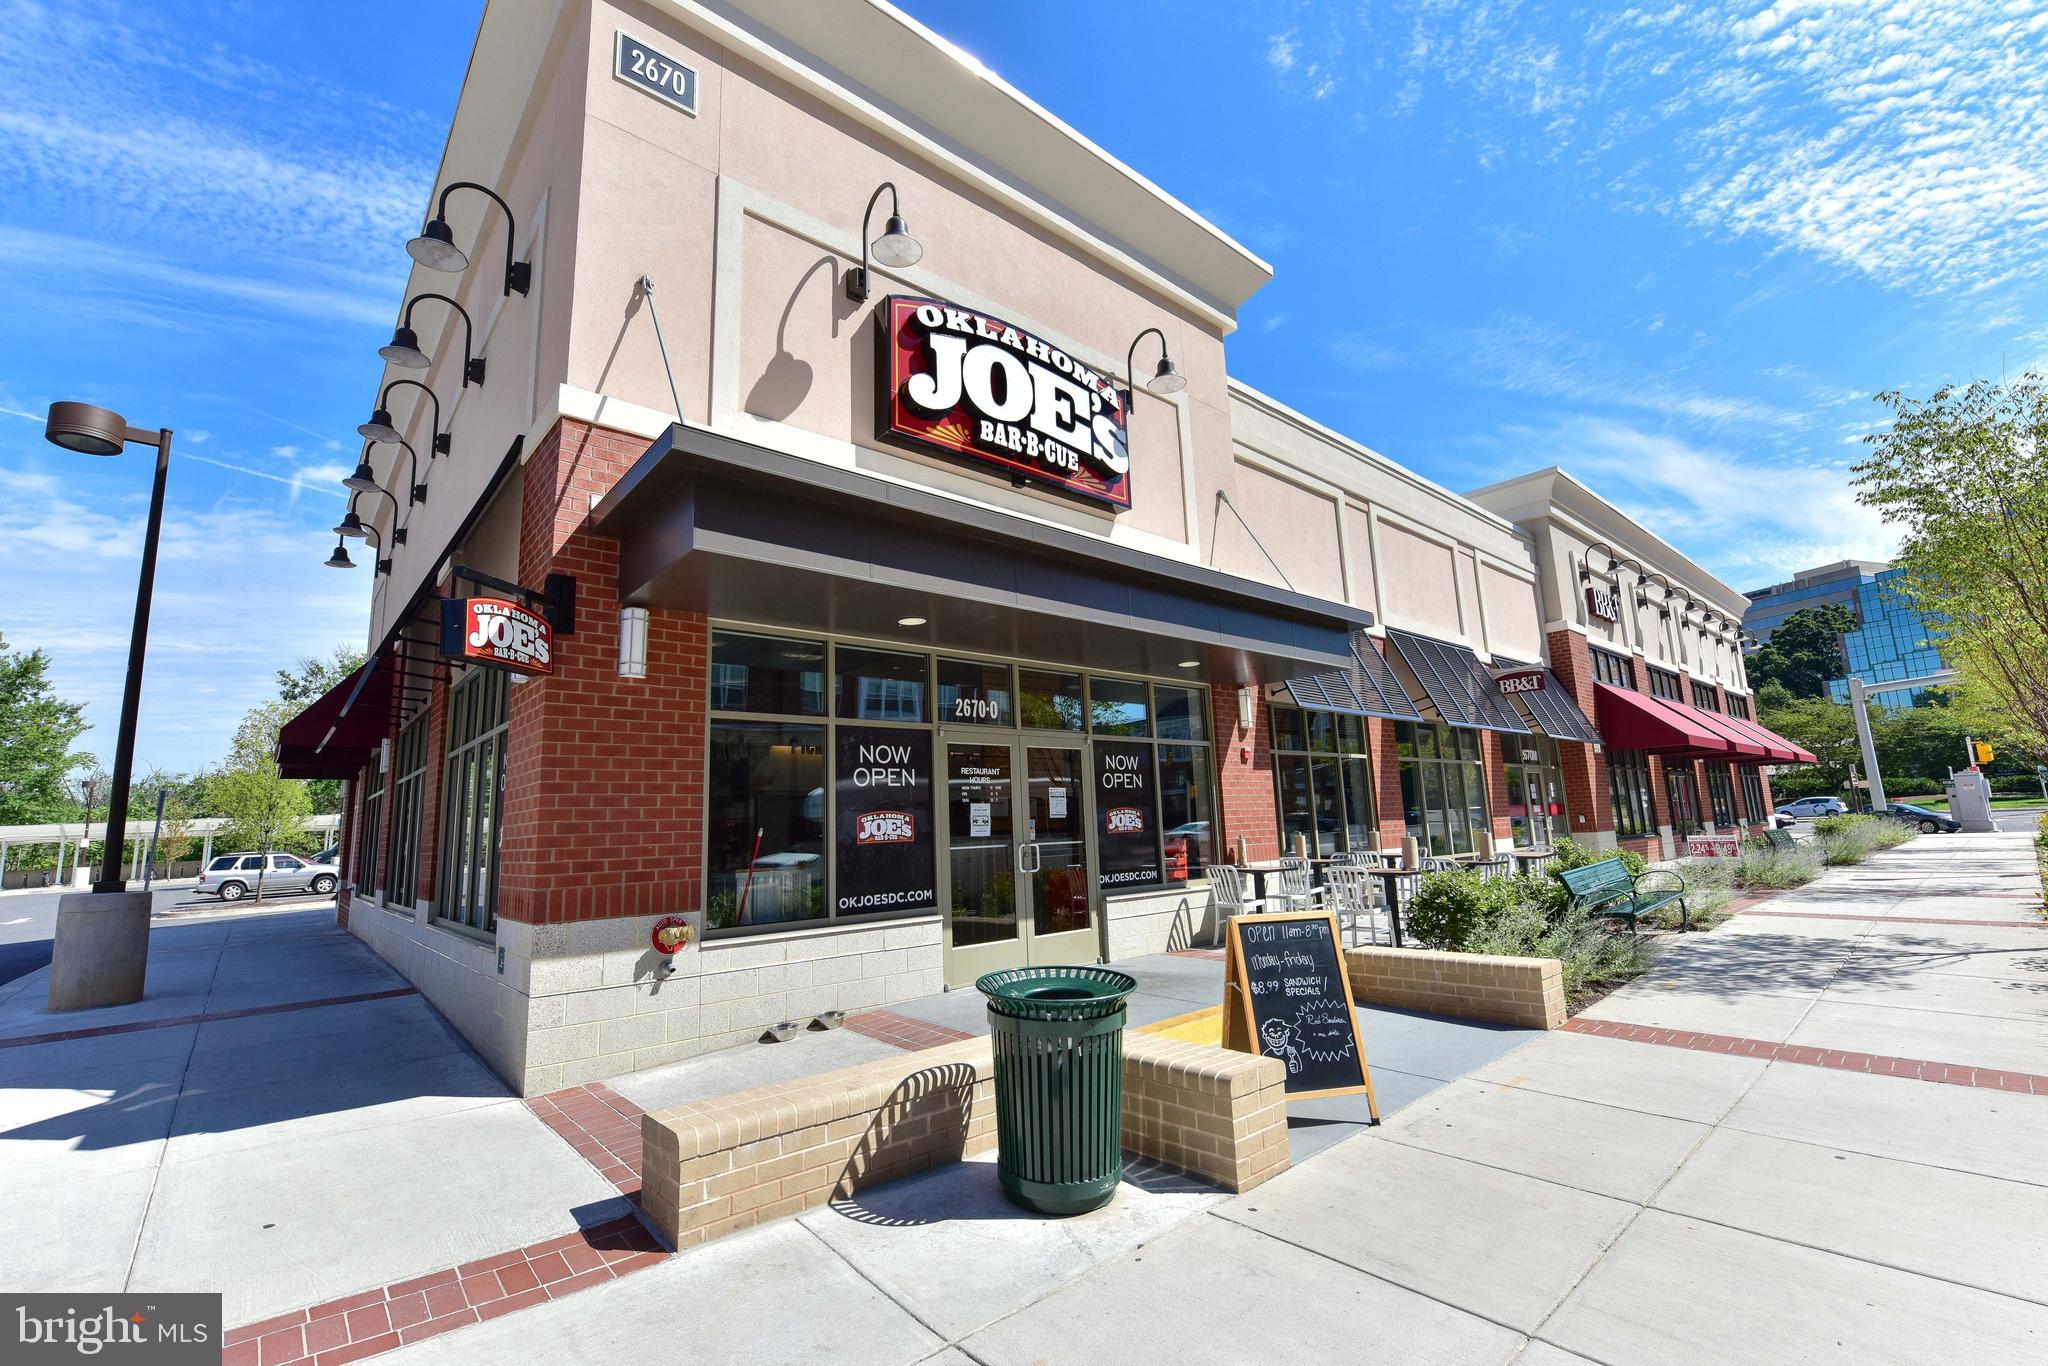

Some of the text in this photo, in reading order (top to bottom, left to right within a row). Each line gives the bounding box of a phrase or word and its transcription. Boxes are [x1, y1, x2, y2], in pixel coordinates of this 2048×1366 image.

[631, 49, 685, 96] 2670
[916, 305, 1120, 410] OKLAHOMA
[908, 332, 1129, 474] JOE'S
[473, 604, 547, 636] OKLAHOMA
[469, 614, 550, 664] JOE'S
[1499, 675, 1541, 694] BB&T
[859, 745, 911, 764] NOW
[1105, 754, 1139, 771] NOW
[853, 767, 916, 787] OPEN
[961, 767, 1000, 775] RESTAURANT
[969, 776, 992, 784] HOURS
[1102, 773, 1143, 788] OPEN
[861, 813, 910, 823] OKLAHOMA
[1108, 813, 1142, 830] JOE'S
[859, 818, 912, 840] JOE'S
[1099, 870, 1158, 884] OKJOESDC.COM
[838, 889, 933, 909] OKJOESDC.COM
[1250, 976, 1321, 995] $8.99 SANDWICH
[1285, 987, 1321, 997] SPECIALS
